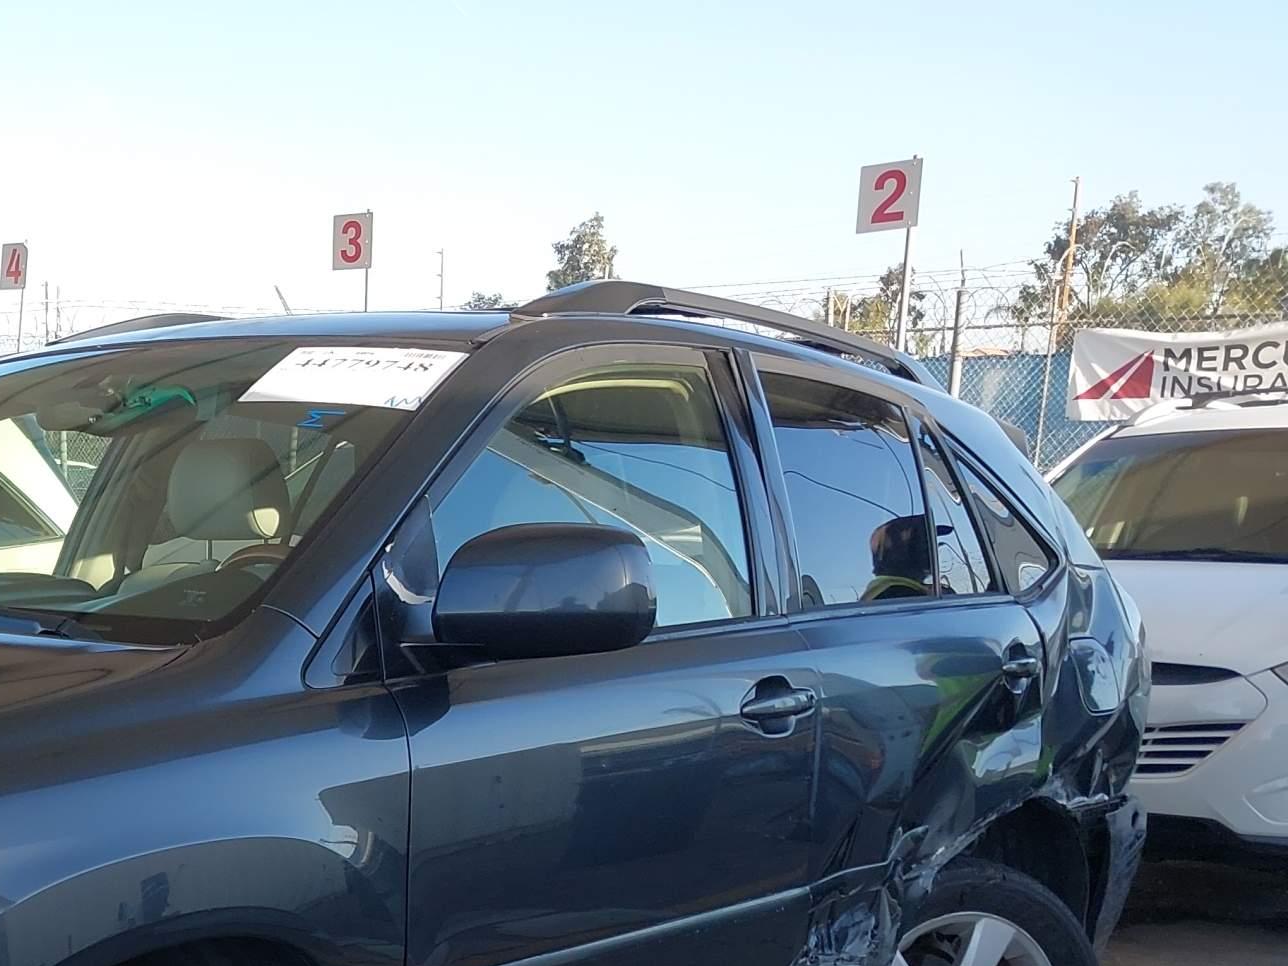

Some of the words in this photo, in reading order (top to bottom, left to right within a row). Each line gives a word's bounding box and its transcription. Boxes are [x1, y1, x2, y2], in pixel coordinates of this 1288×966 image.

[871, 169, 907, 224] 2
[340, 220, 362, 263] 3
[5, 248, 21, 284] 4
[295, 358, 434, 372] 44779748
[1163, 341, 1288, 372] MERC
